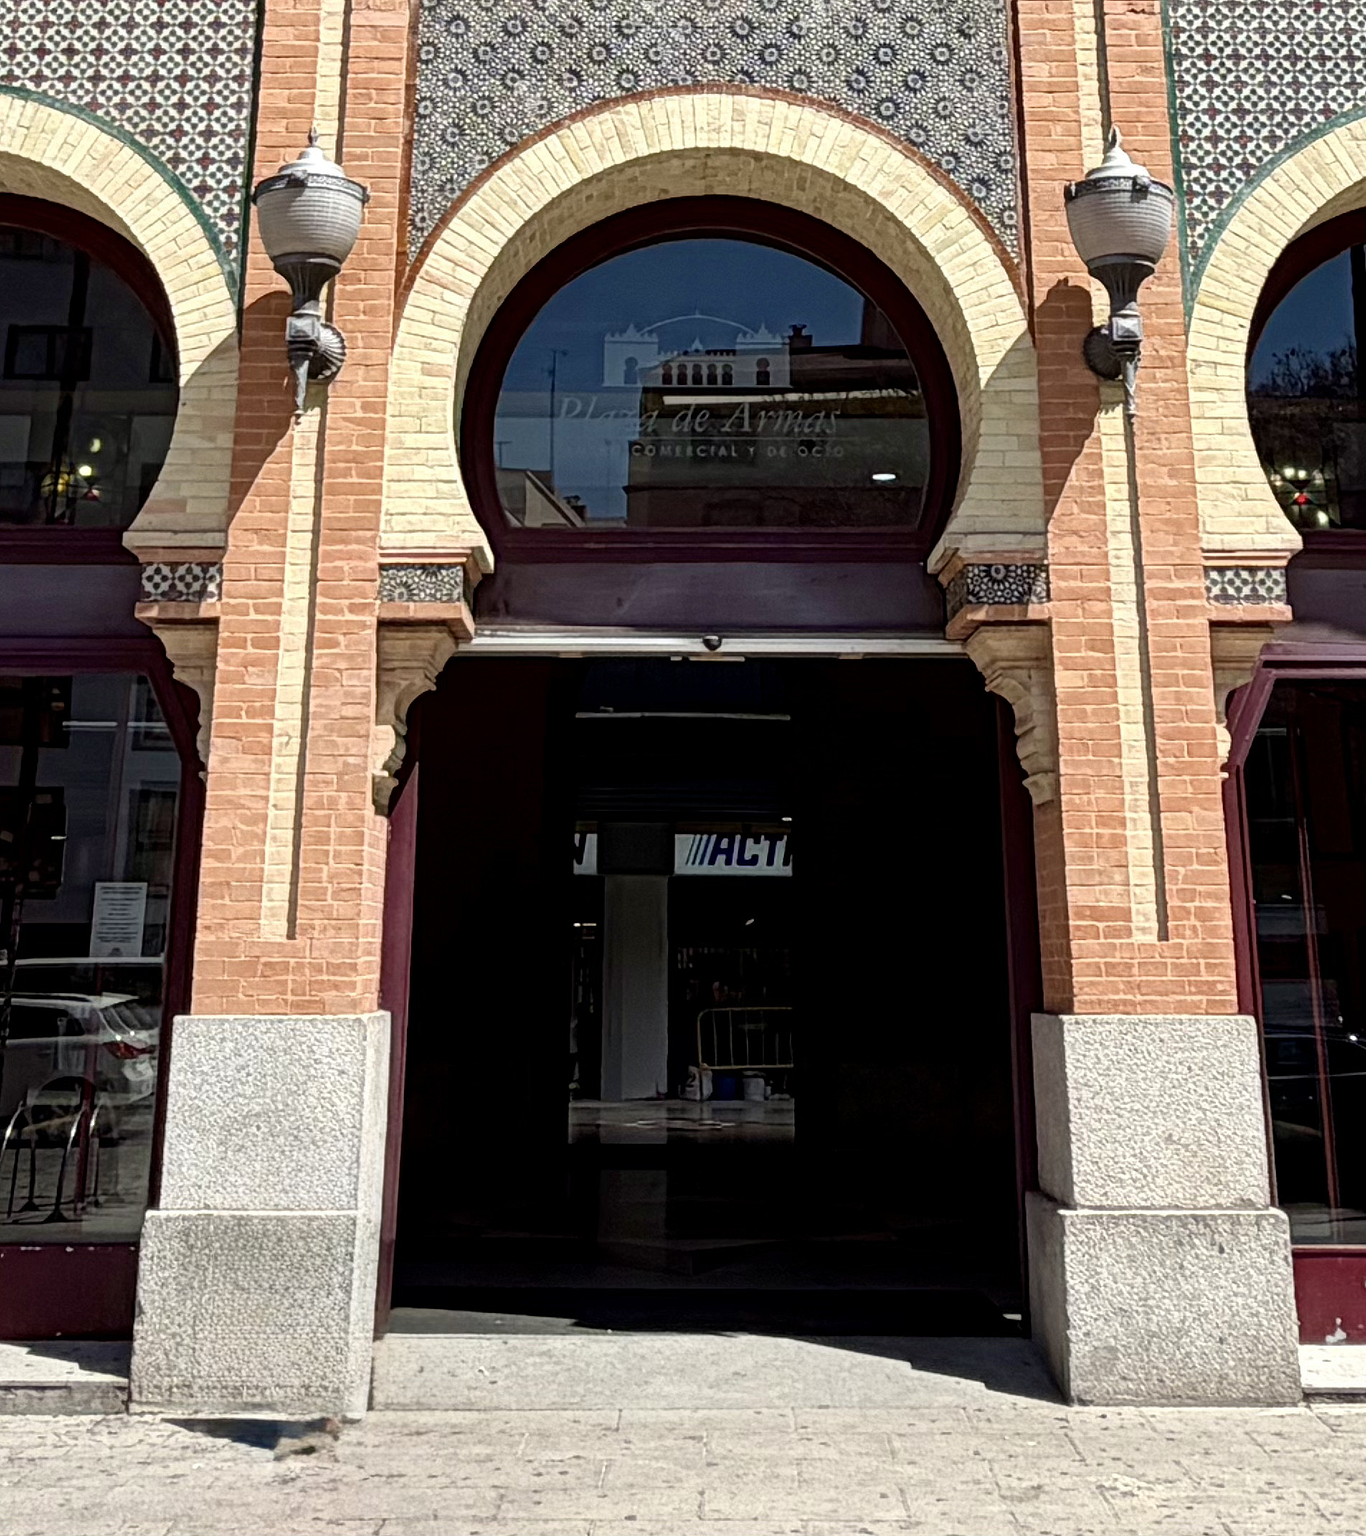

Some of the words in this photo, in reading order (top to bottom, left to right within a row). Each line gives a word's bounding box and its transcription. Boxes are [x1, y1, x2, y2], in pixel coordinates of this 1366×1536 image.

[557, 397, 659, 433] Plaza
[671, 404, 714, 433] de
[721, 402, 842, 434] Armas
